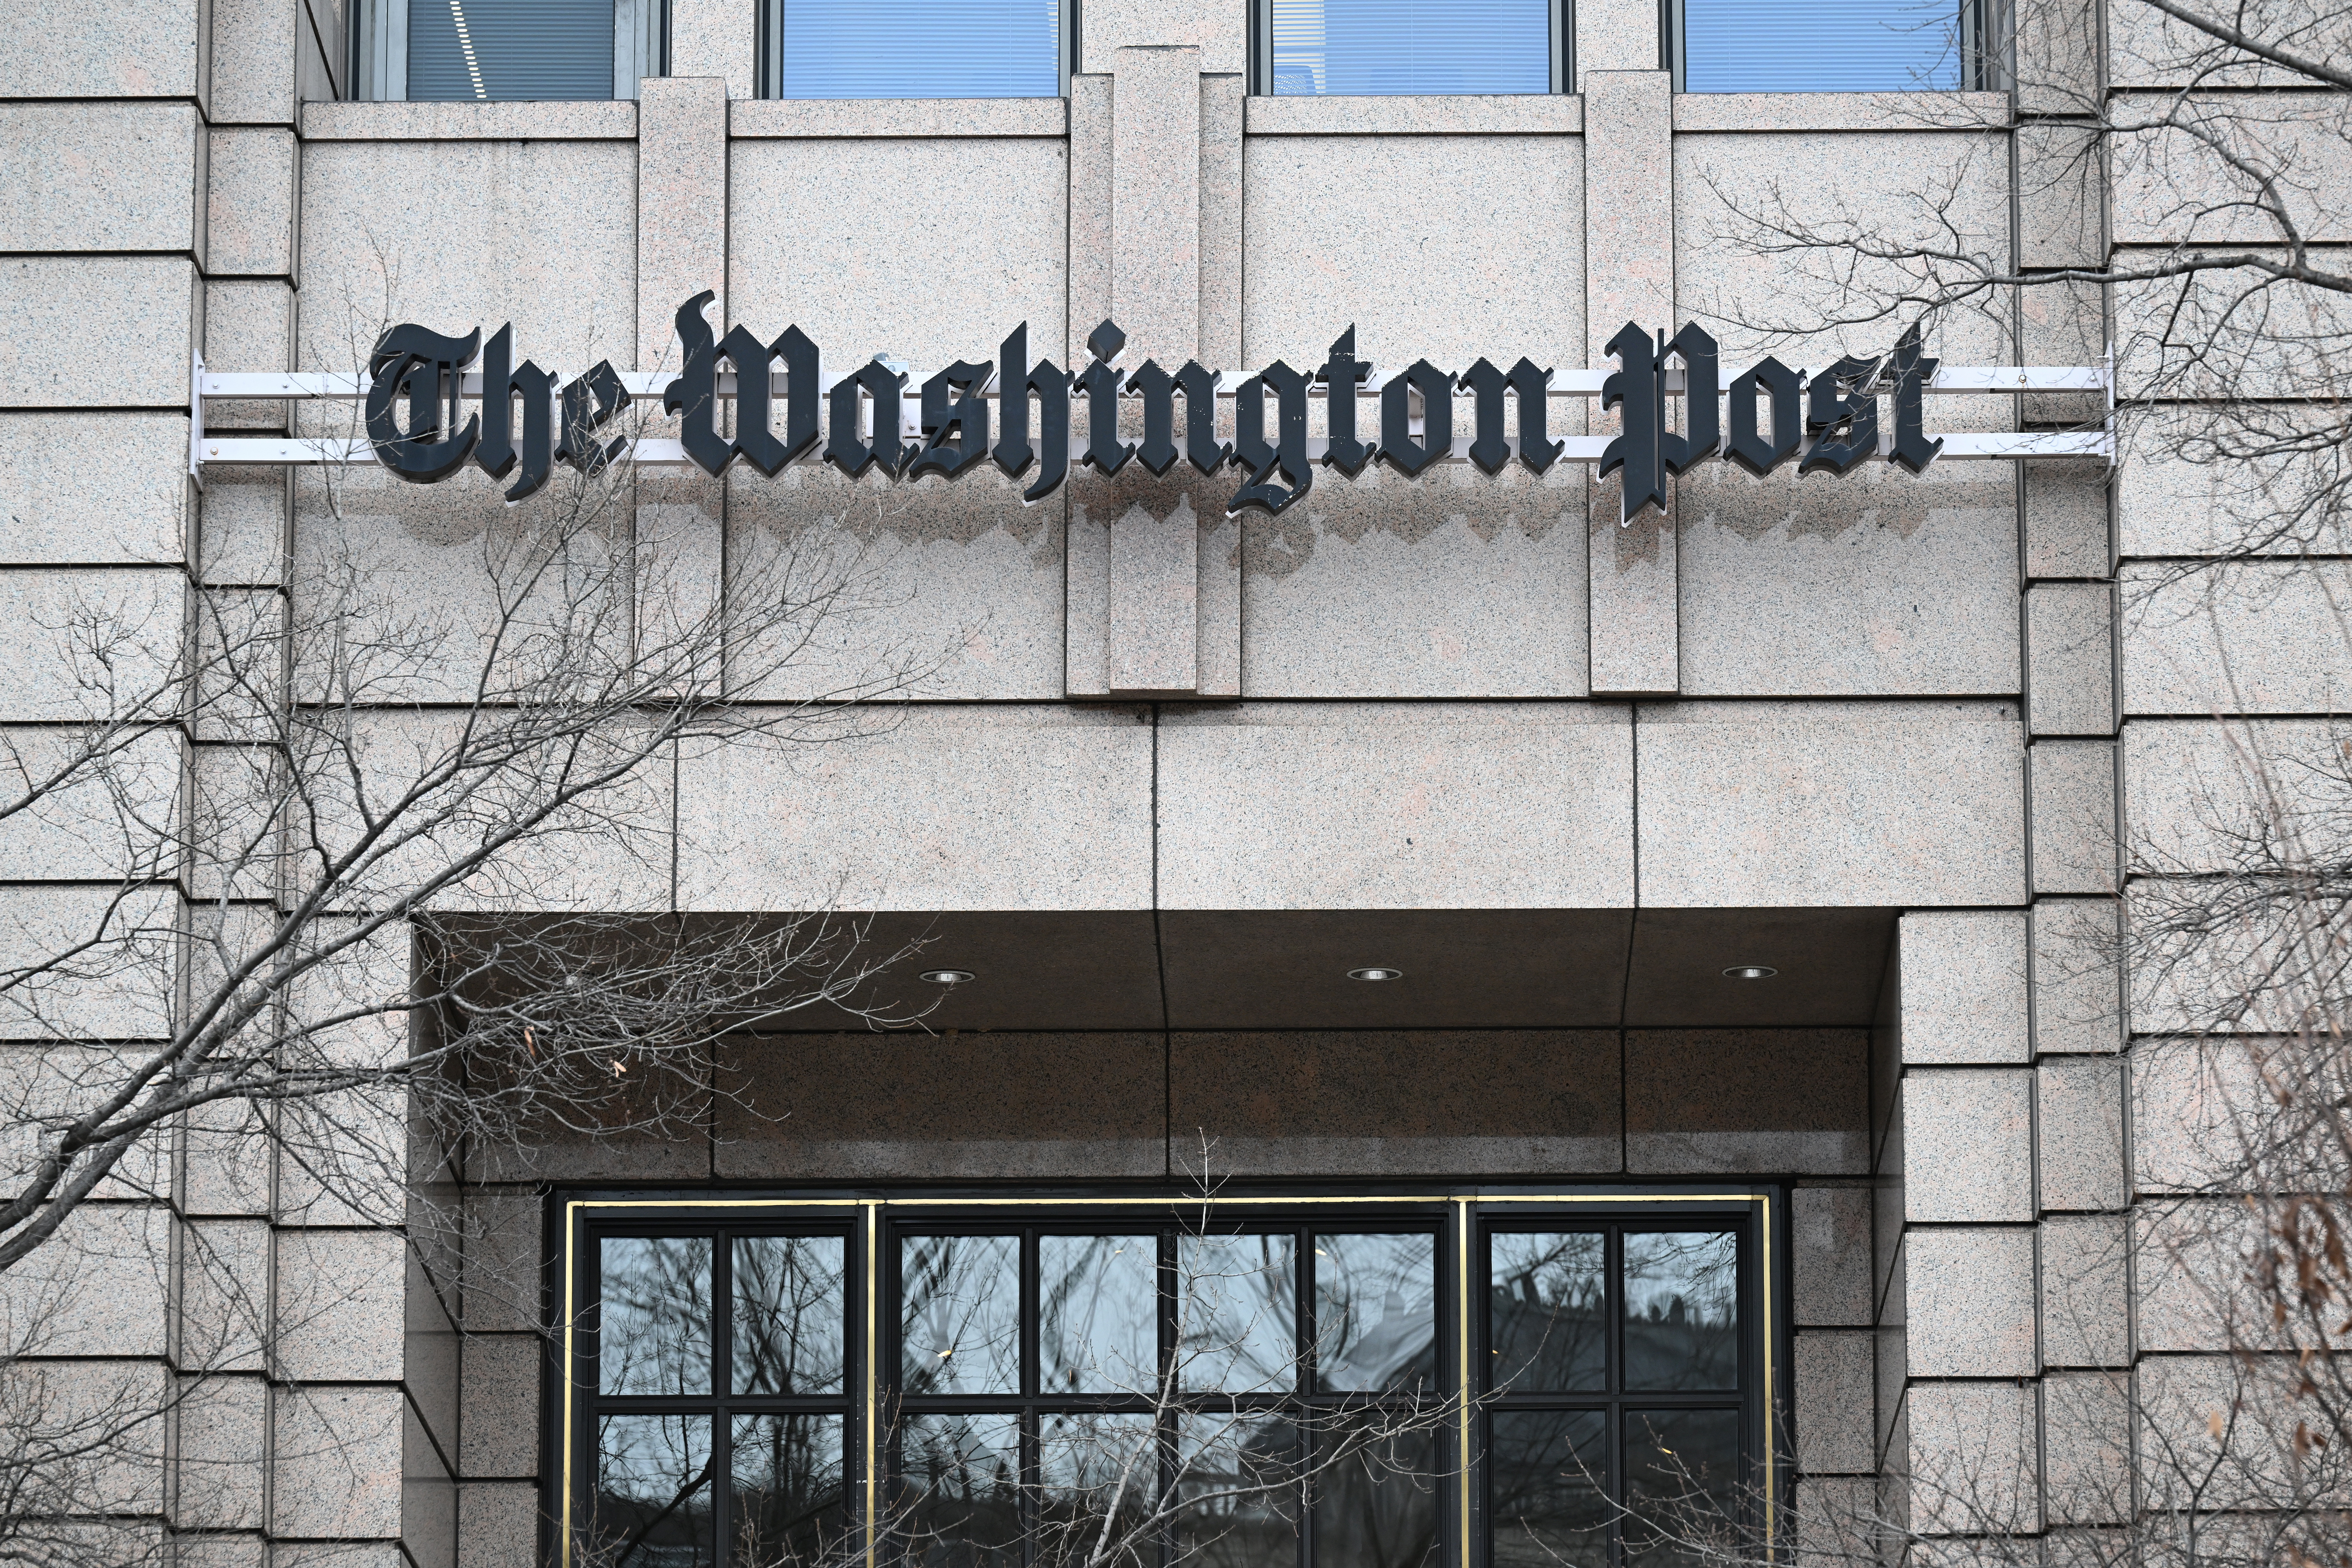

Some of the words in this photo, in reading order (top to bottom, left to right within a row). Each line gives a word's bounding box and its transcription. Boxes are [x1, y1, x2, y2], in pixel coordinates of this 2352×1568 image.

[365, 321, 634, 507] The
[663, 289, 1565, 519] Washington
[1600, 320, 1945, 527] Post
